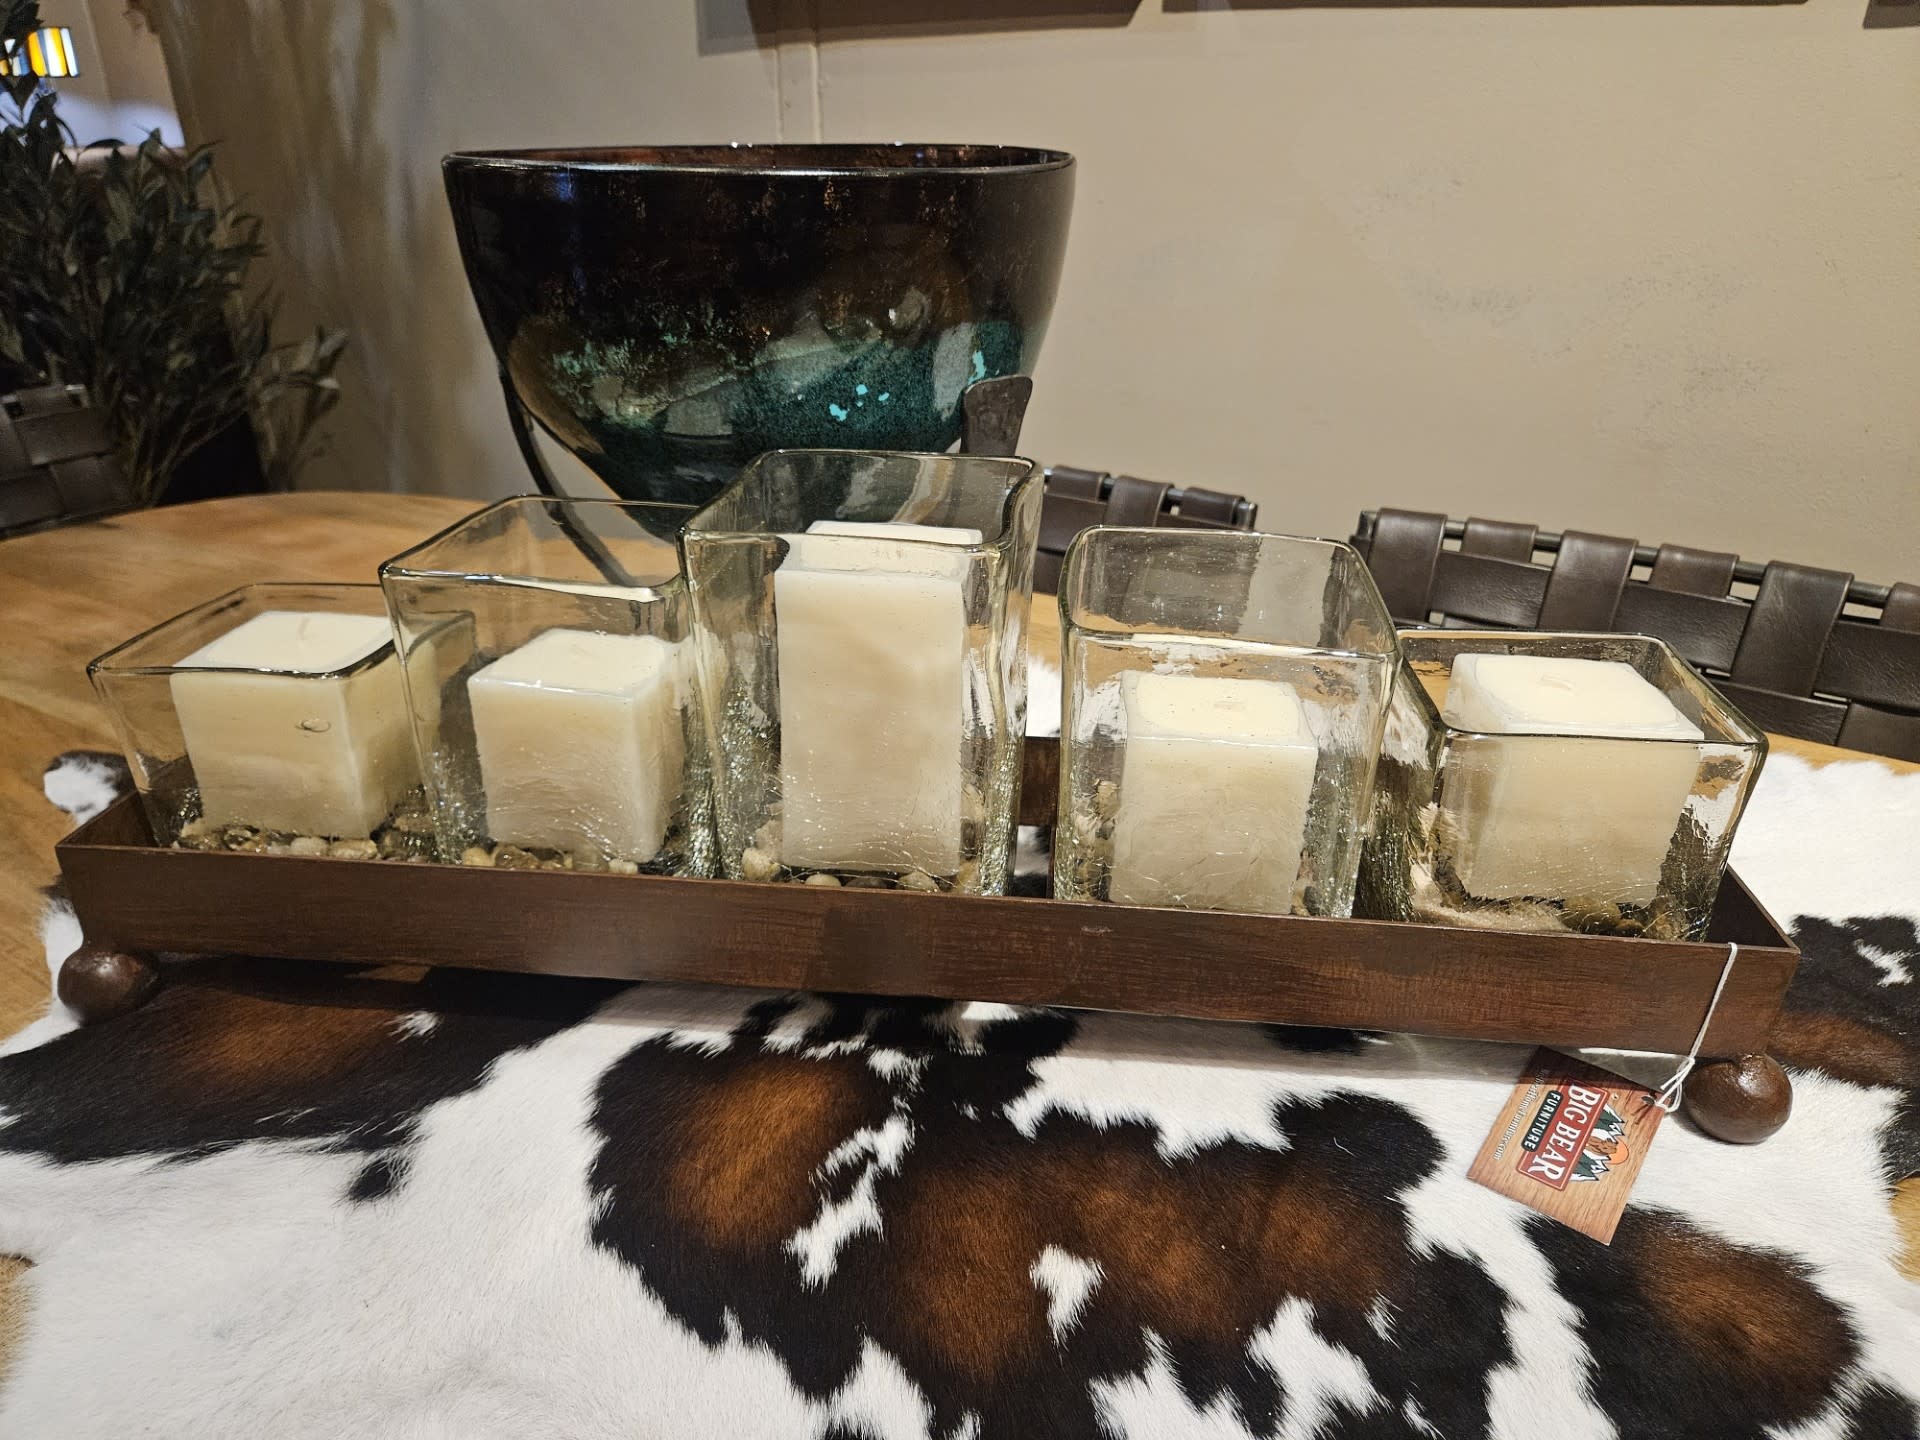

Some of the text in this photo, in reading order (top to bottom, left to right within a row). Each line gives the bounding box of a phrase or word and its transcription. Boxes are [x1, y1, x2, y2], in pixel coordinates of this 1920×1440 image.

[1525, 1092, 1561, 1150] FURNITURE
[1528, 1084, 1601, 1180] BIG BEAR
